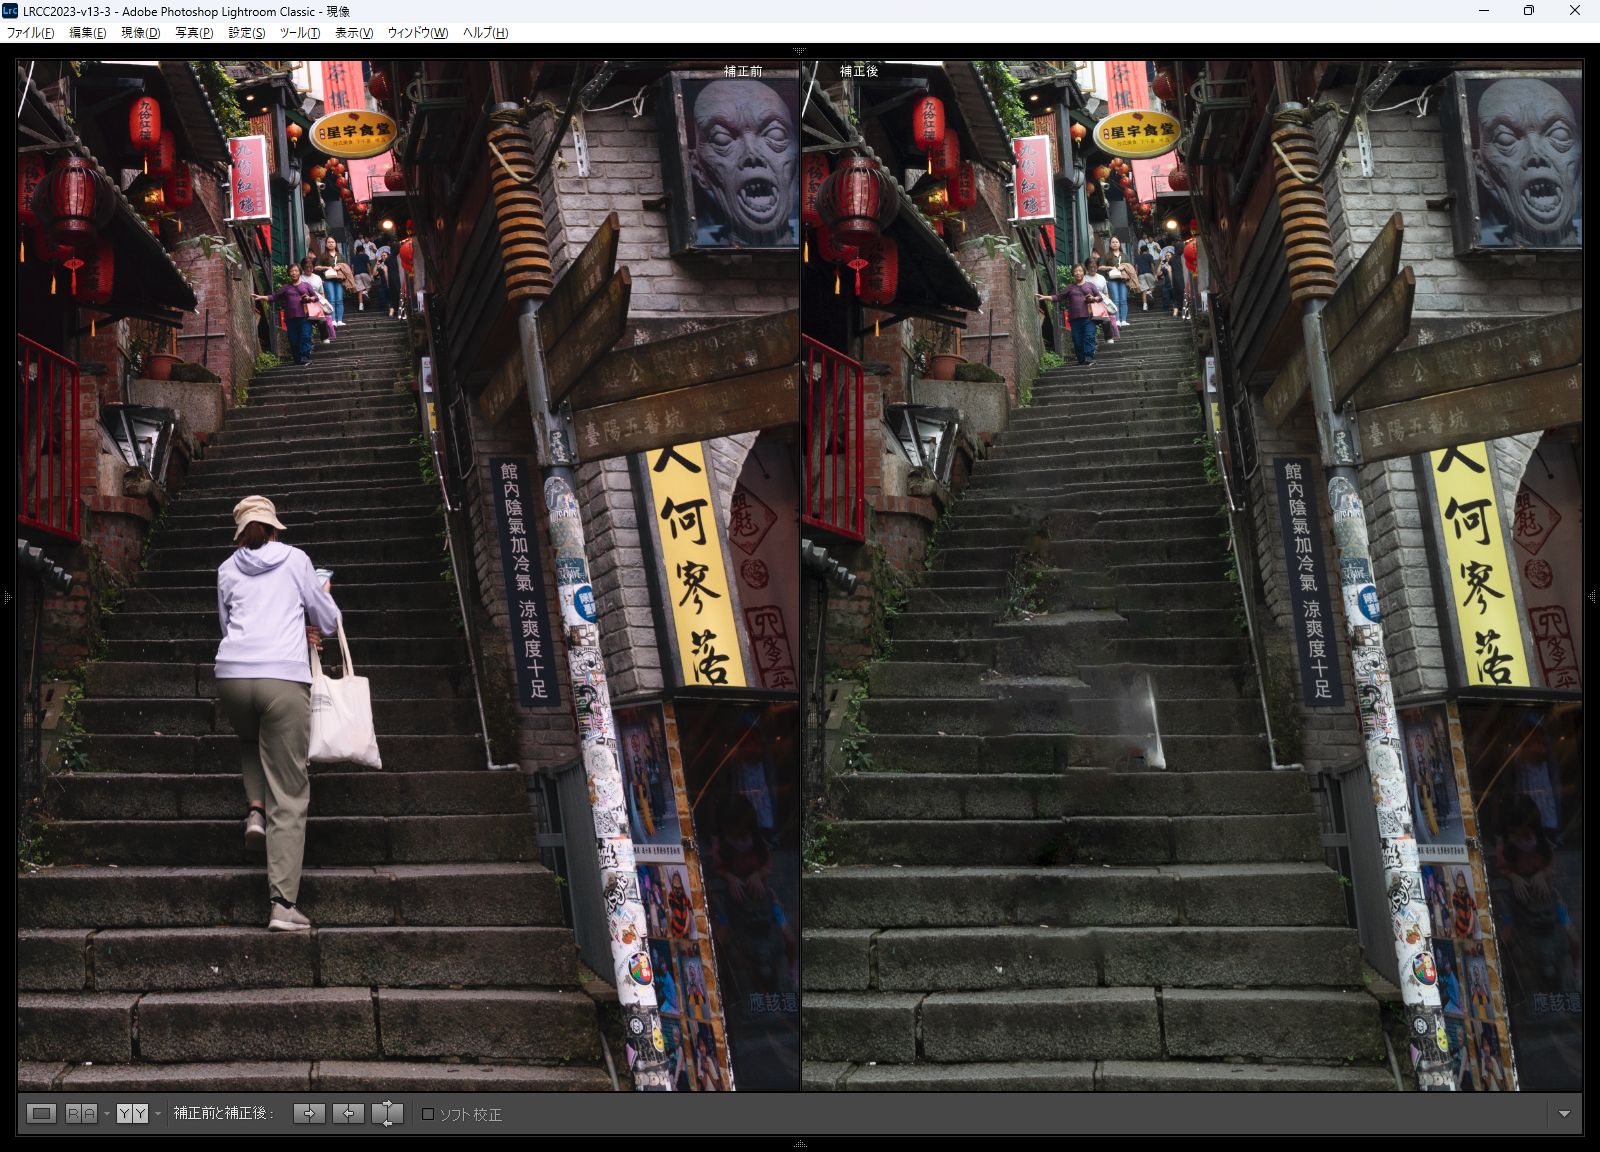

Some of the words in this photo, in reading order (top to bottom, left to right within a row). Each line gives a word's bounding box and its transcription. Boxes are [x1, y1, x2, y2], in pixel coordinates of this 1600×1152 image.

[23, 6, 111, 17] LRCC2023-v13-3
[122, 6, 158, 17] Adobe
[161, 6, 218, 20] Photoshop
[221, 6, 277, 20] Lightroom
[280, 6, 316, 17] Classic
[326, 6, 351, 17] 現像
[8, 26, 54, 39] ファイル(F)
[69, 26, 107, 39] 編集(E)
[122, 26, 161, 39] 現像(D)
[175, 26, 214, 39] 写真(P)
[228, 26, 266, 39] 設定(S)
[281, 26, 321, 39] ツール(T)
[335, 26, 374, 39] 表示(V)
[388, 26, 449, 39] ウィンドウ(W)
[464, 26, 509, 39] ヘルプ(H)
[723, 64, 763, 78] 補正前
[839, 64, 879, 78] 補正後
[500, 462, 534, 592] 館內陰氣加冷氣
[518, 600, 549, 699] 涼爽度十足
[1284, 462, 1318, 592] 館內陰氣加冷氣
[1302, 600, 1333, 699] 涼爽度十足
[440, 1107, 503, 1122] ソフト校正
